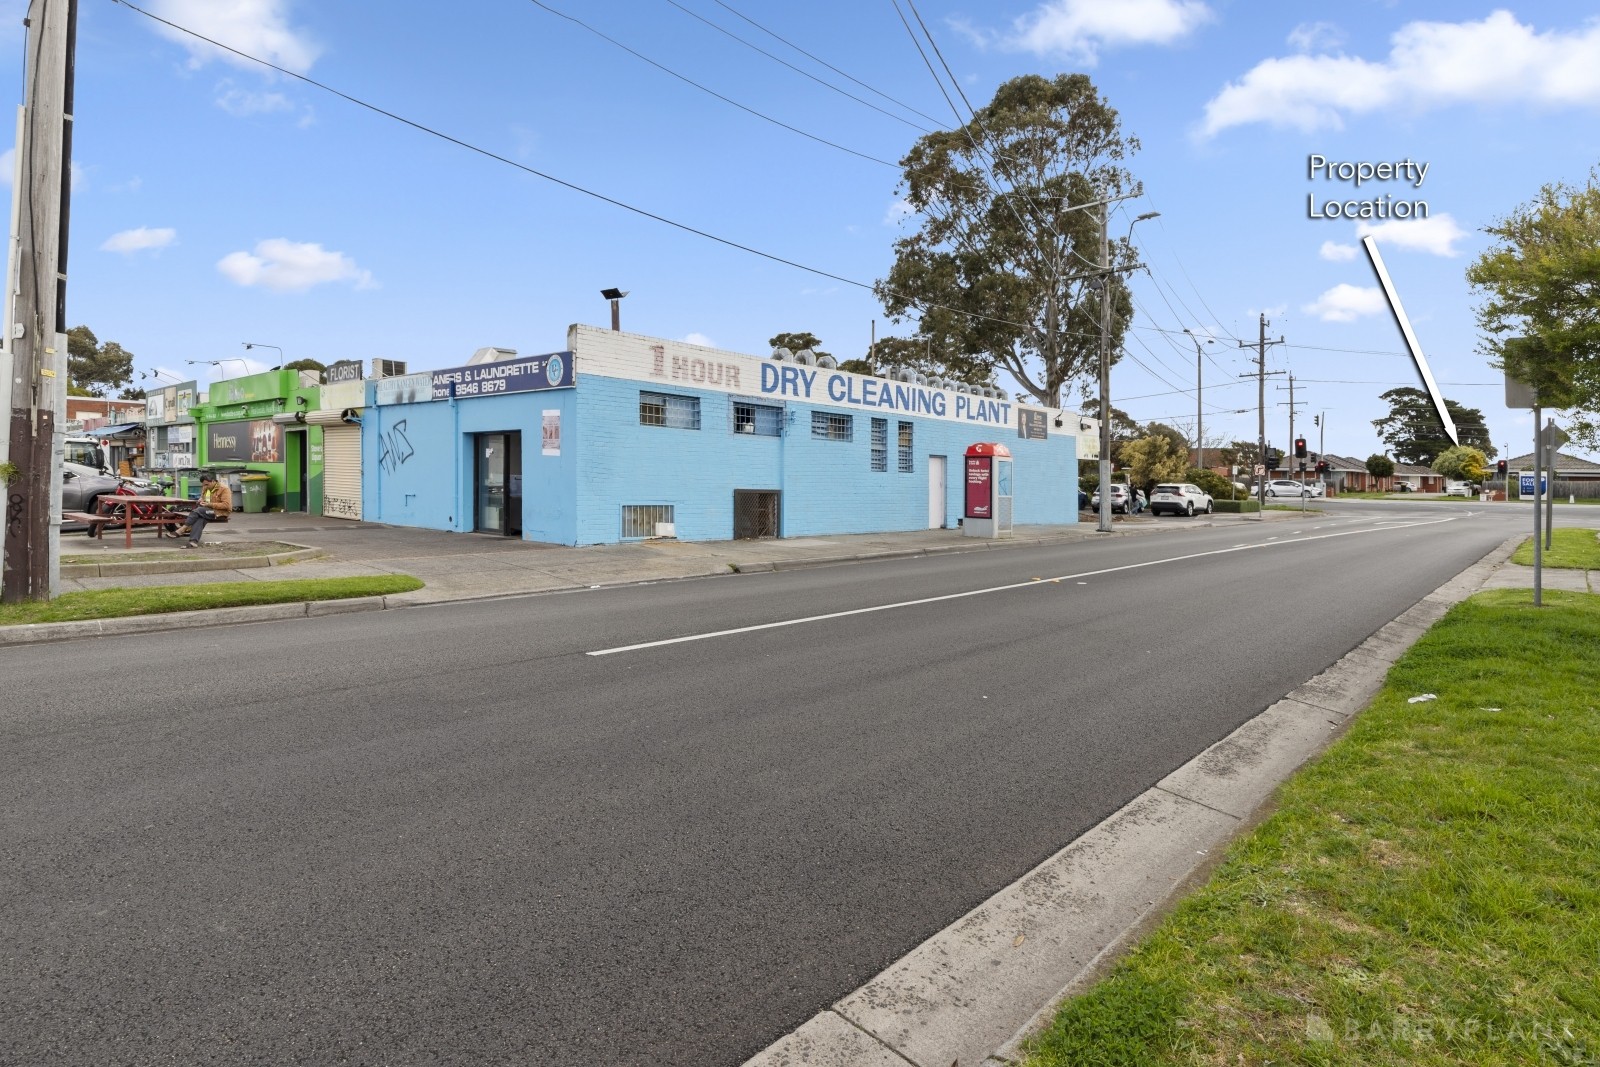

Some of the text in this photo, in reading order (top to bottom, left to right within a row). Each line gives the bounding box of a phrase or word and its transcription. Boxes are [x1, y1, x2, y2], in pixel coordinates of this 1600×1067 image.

[330, 363, 360, 381] FLORIST
[464, 369, 473, 382] &
[474, 360, 540, 380] LAUNDRETTE
[455, 381, 479, 396] 9546
[481, 378, 506, 393] 8679
[651, 344, 667, 378] 1
[671, 355, 741, 388] HOUR
[761, 362, 817, 398] DRY
[827, 374, 946, 417] CLEANING
[955, 395, 1012, 425] PLANT
[213, 432, 237, 452] Hennessy
